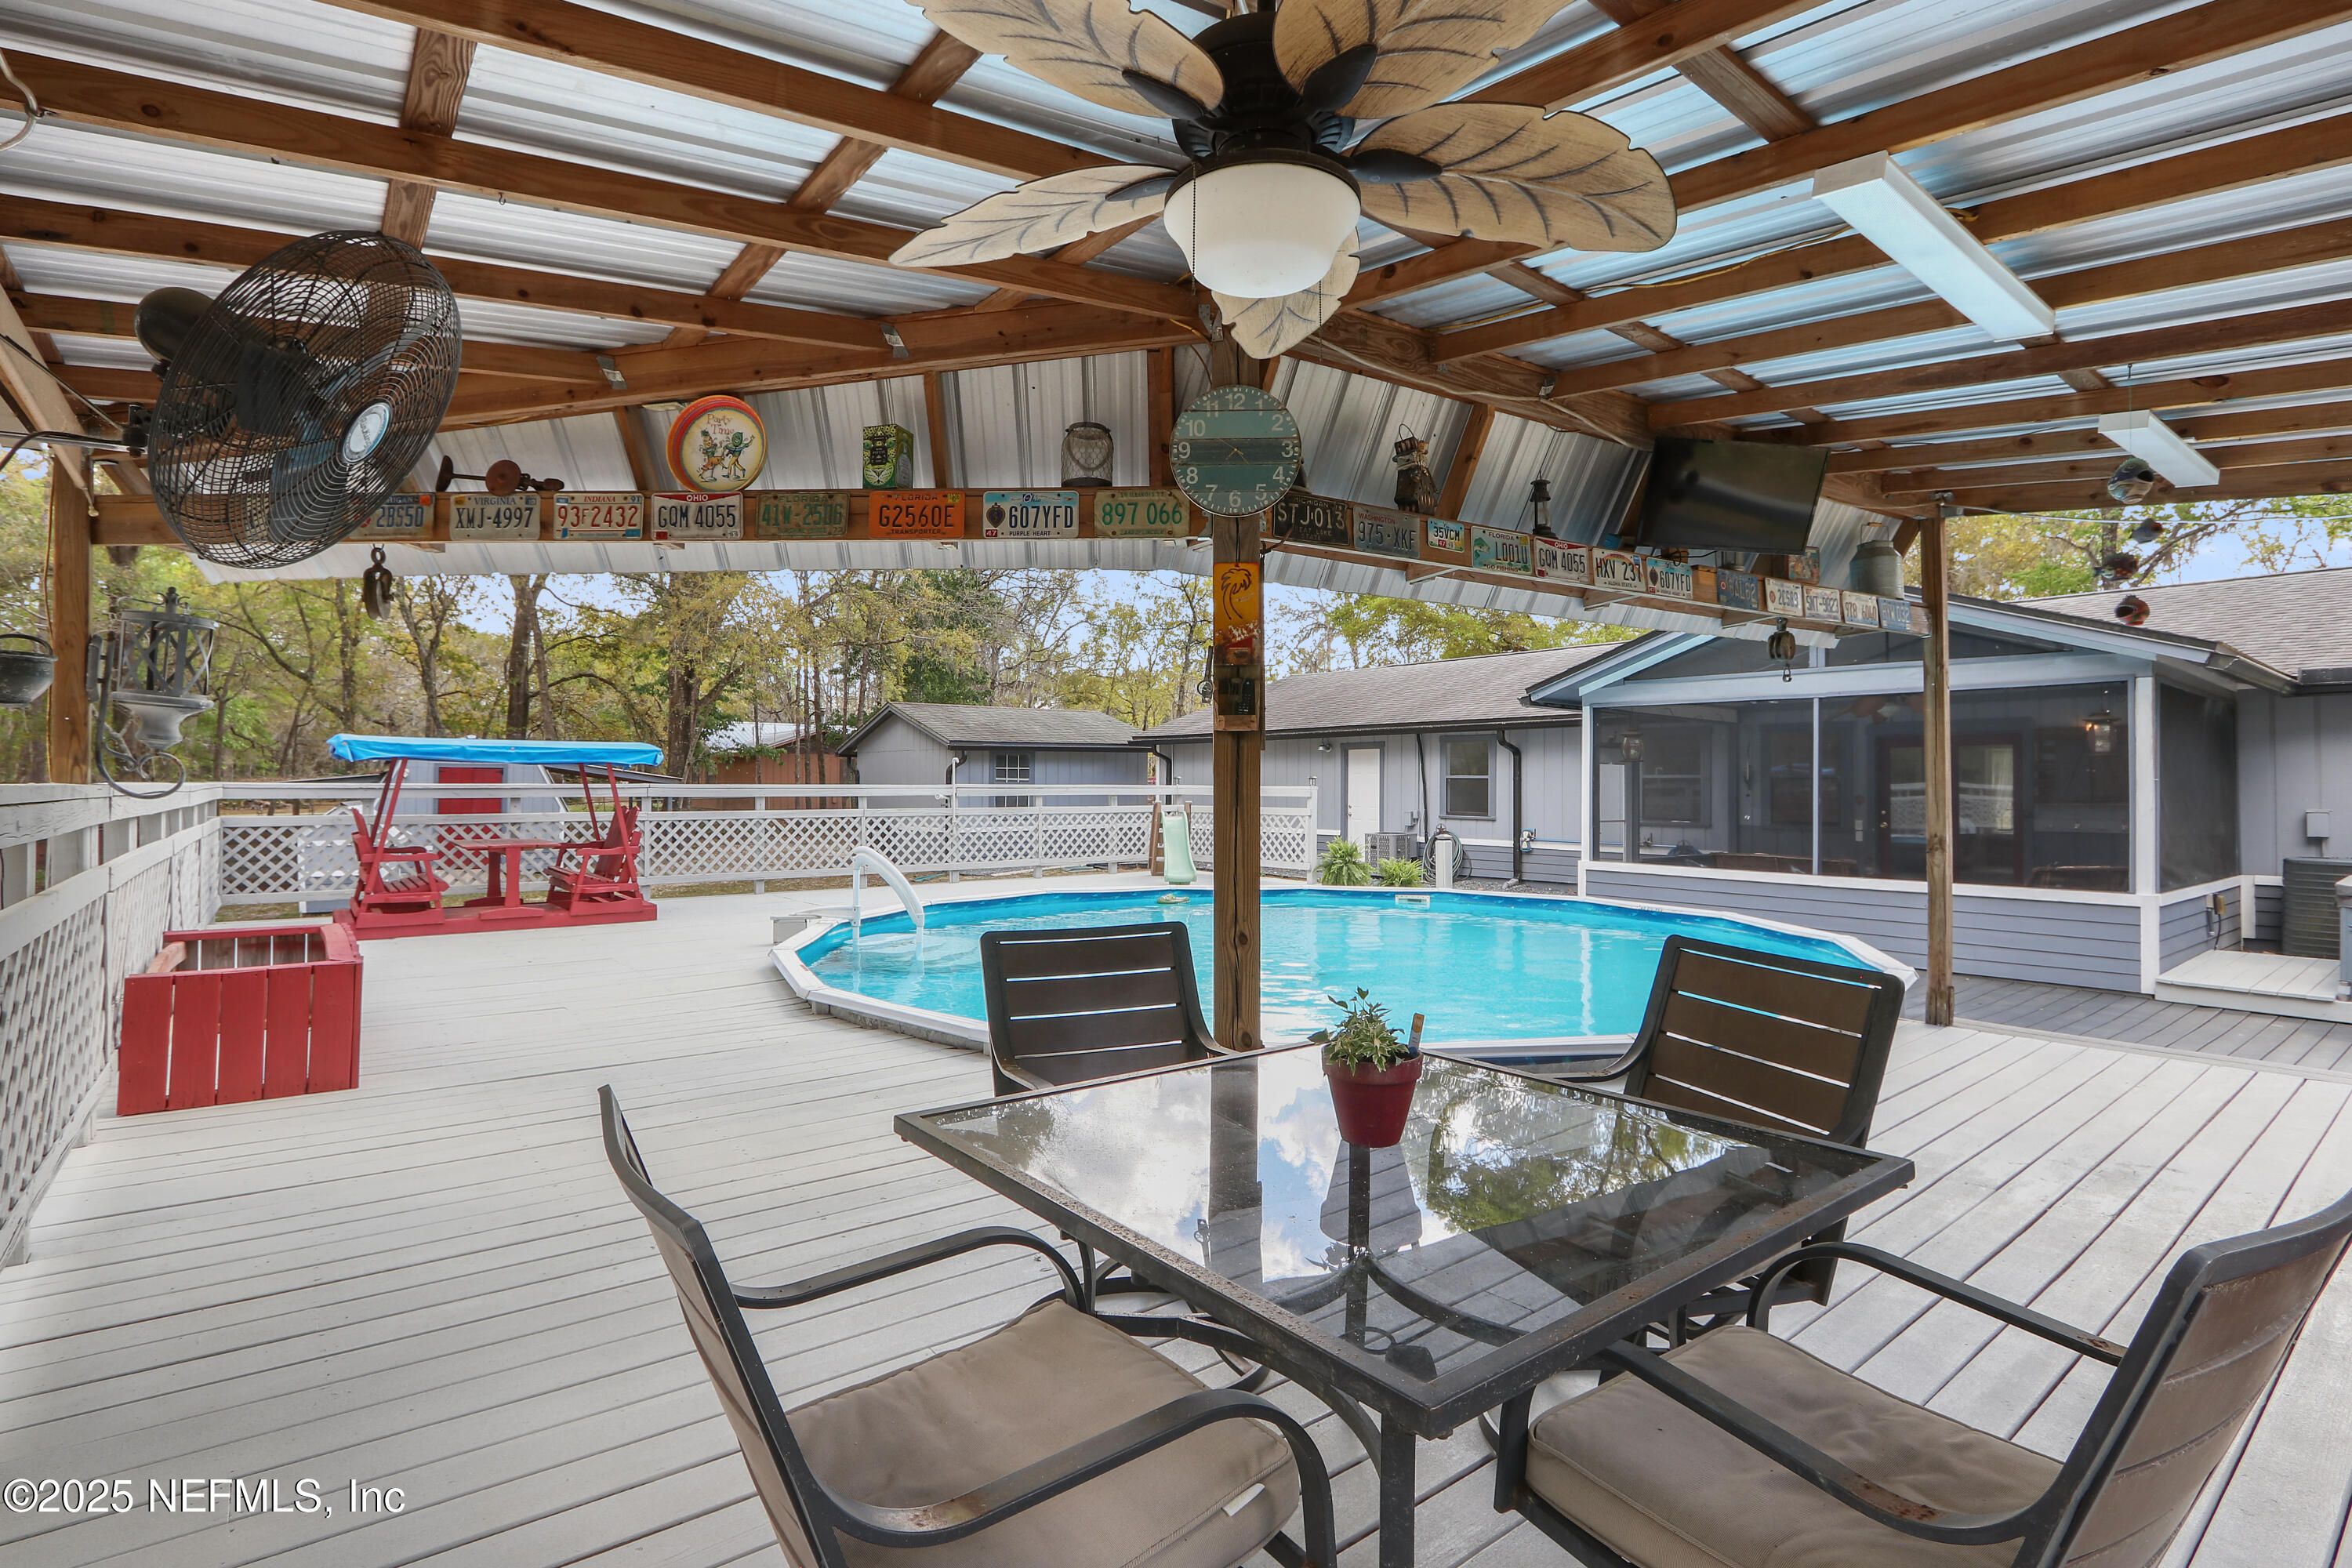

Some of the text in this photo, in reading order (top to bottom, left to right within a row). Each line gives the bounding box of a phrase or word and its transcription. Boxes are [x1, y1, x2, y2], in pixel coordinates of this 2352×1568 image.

[1203, 400, 1219, 417] 11
[1225, 393, 1245, 410] 12
[1255, 399, 1263, 416] 1
[706, 413, 732, 425] Party
[1185, 419, 1206, 437] 10
[1272, 414, 1283, 431] 2
[710, 423, 735, 435] Time
[1178, 441, 1191, 459] 9
[1281, 441, 1294, 458] 3
[1185, 466, 1199, 485] 8
[1272, 466, 1285, 484] 4
[686, 494, 709, 503] OHIO
[1205, 484, 1218, 502] 7
[1229, 490, 1241, 508] 6
[1255, 483, 1267, 501] 5
[474, 497, 517, 506] VIRGINIA
[658, 505, 736, 528] GQM 4055
[879, 505, 955, 528] G2560E
[1009, 506, 1073, 528] 607YFD
[1102, 503, 1182, 525] 897 066
[1358, 513, 1396, 524] WASHINGTON
[1488, 532, 1514, 541] FLORIDA
[1561, 552, 1586, 573] 4055
[1595, 557, 1642, 582] HXV 237
[1660, 570, 1690, 592] 607YFD
